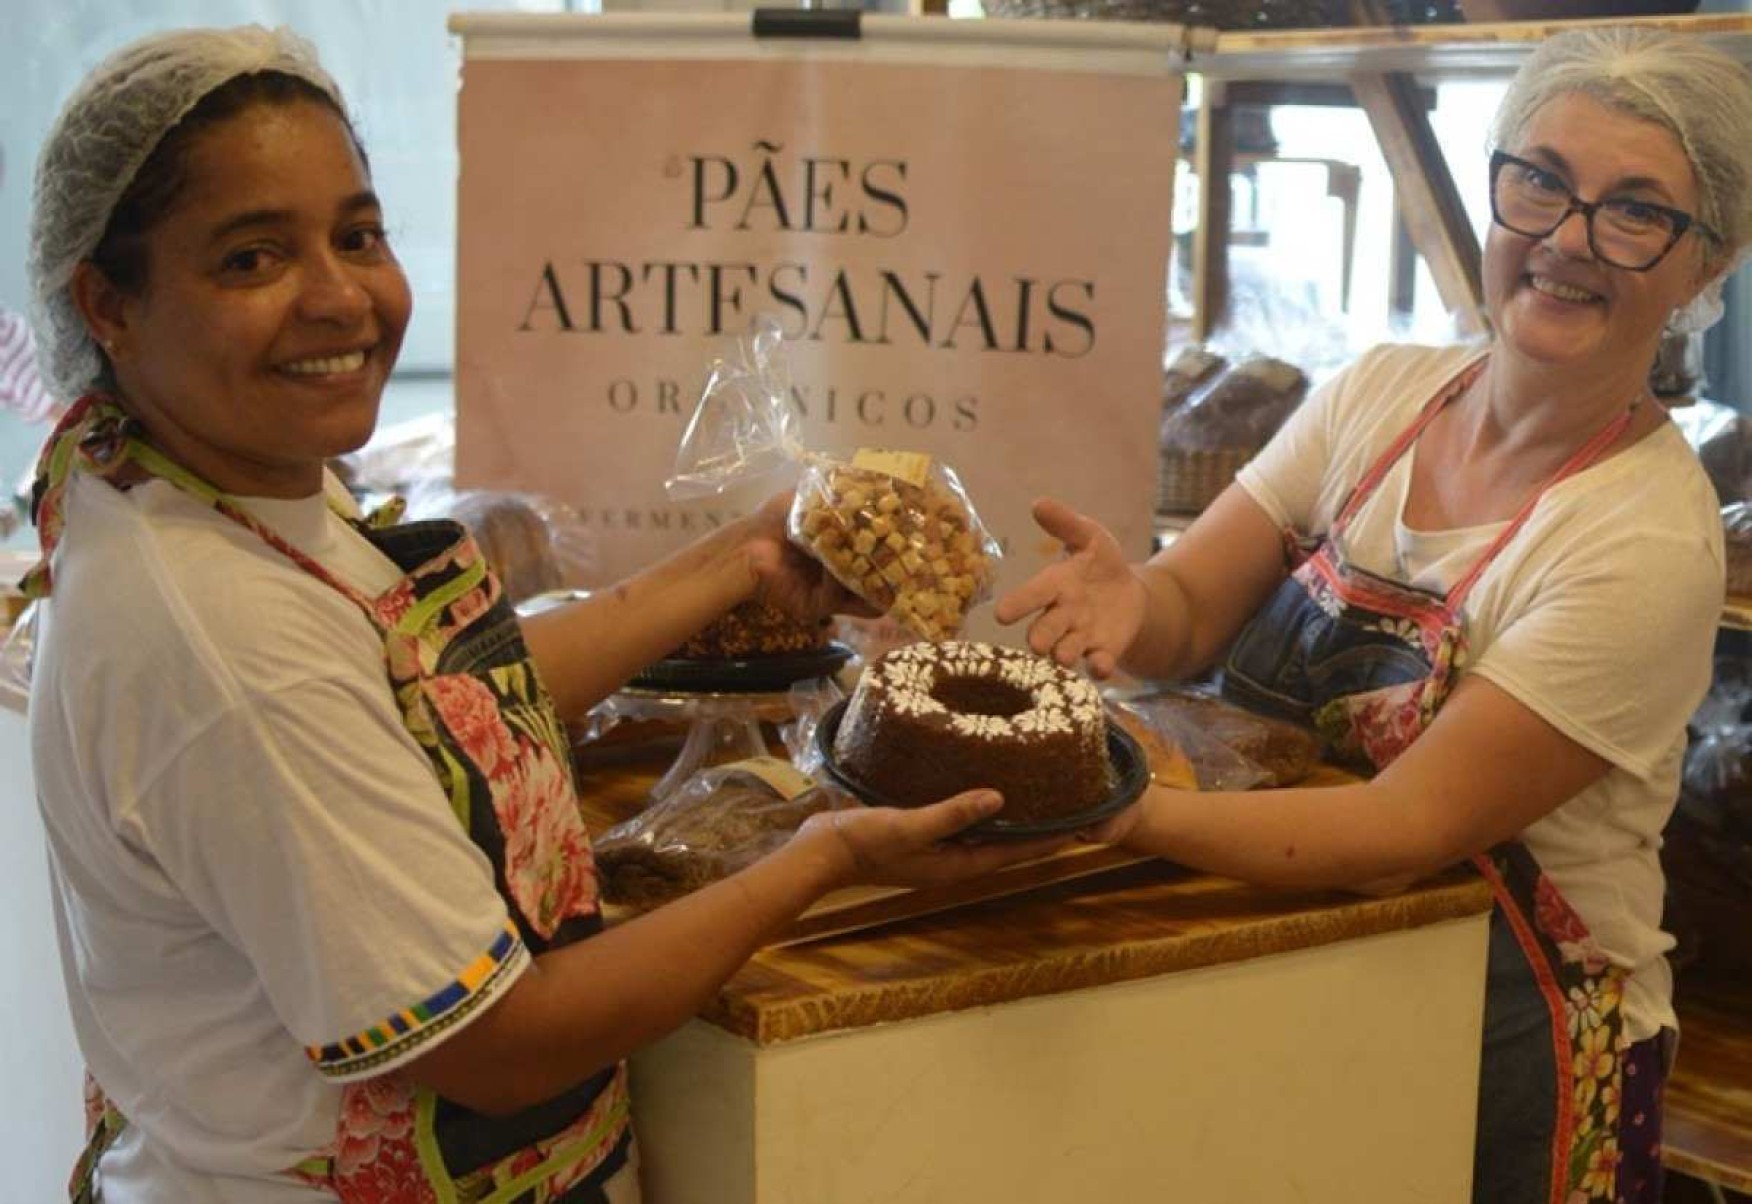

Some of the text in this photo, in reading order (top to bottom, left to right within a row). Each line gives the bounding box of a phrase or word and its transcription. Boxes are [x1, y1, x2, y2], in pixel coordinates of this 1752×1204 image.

[687, 138, 910, 238] PÃES
[516, 260, 1097, 359] ARTESANAIS
[607, 379, 979, 432] ORNICOS
